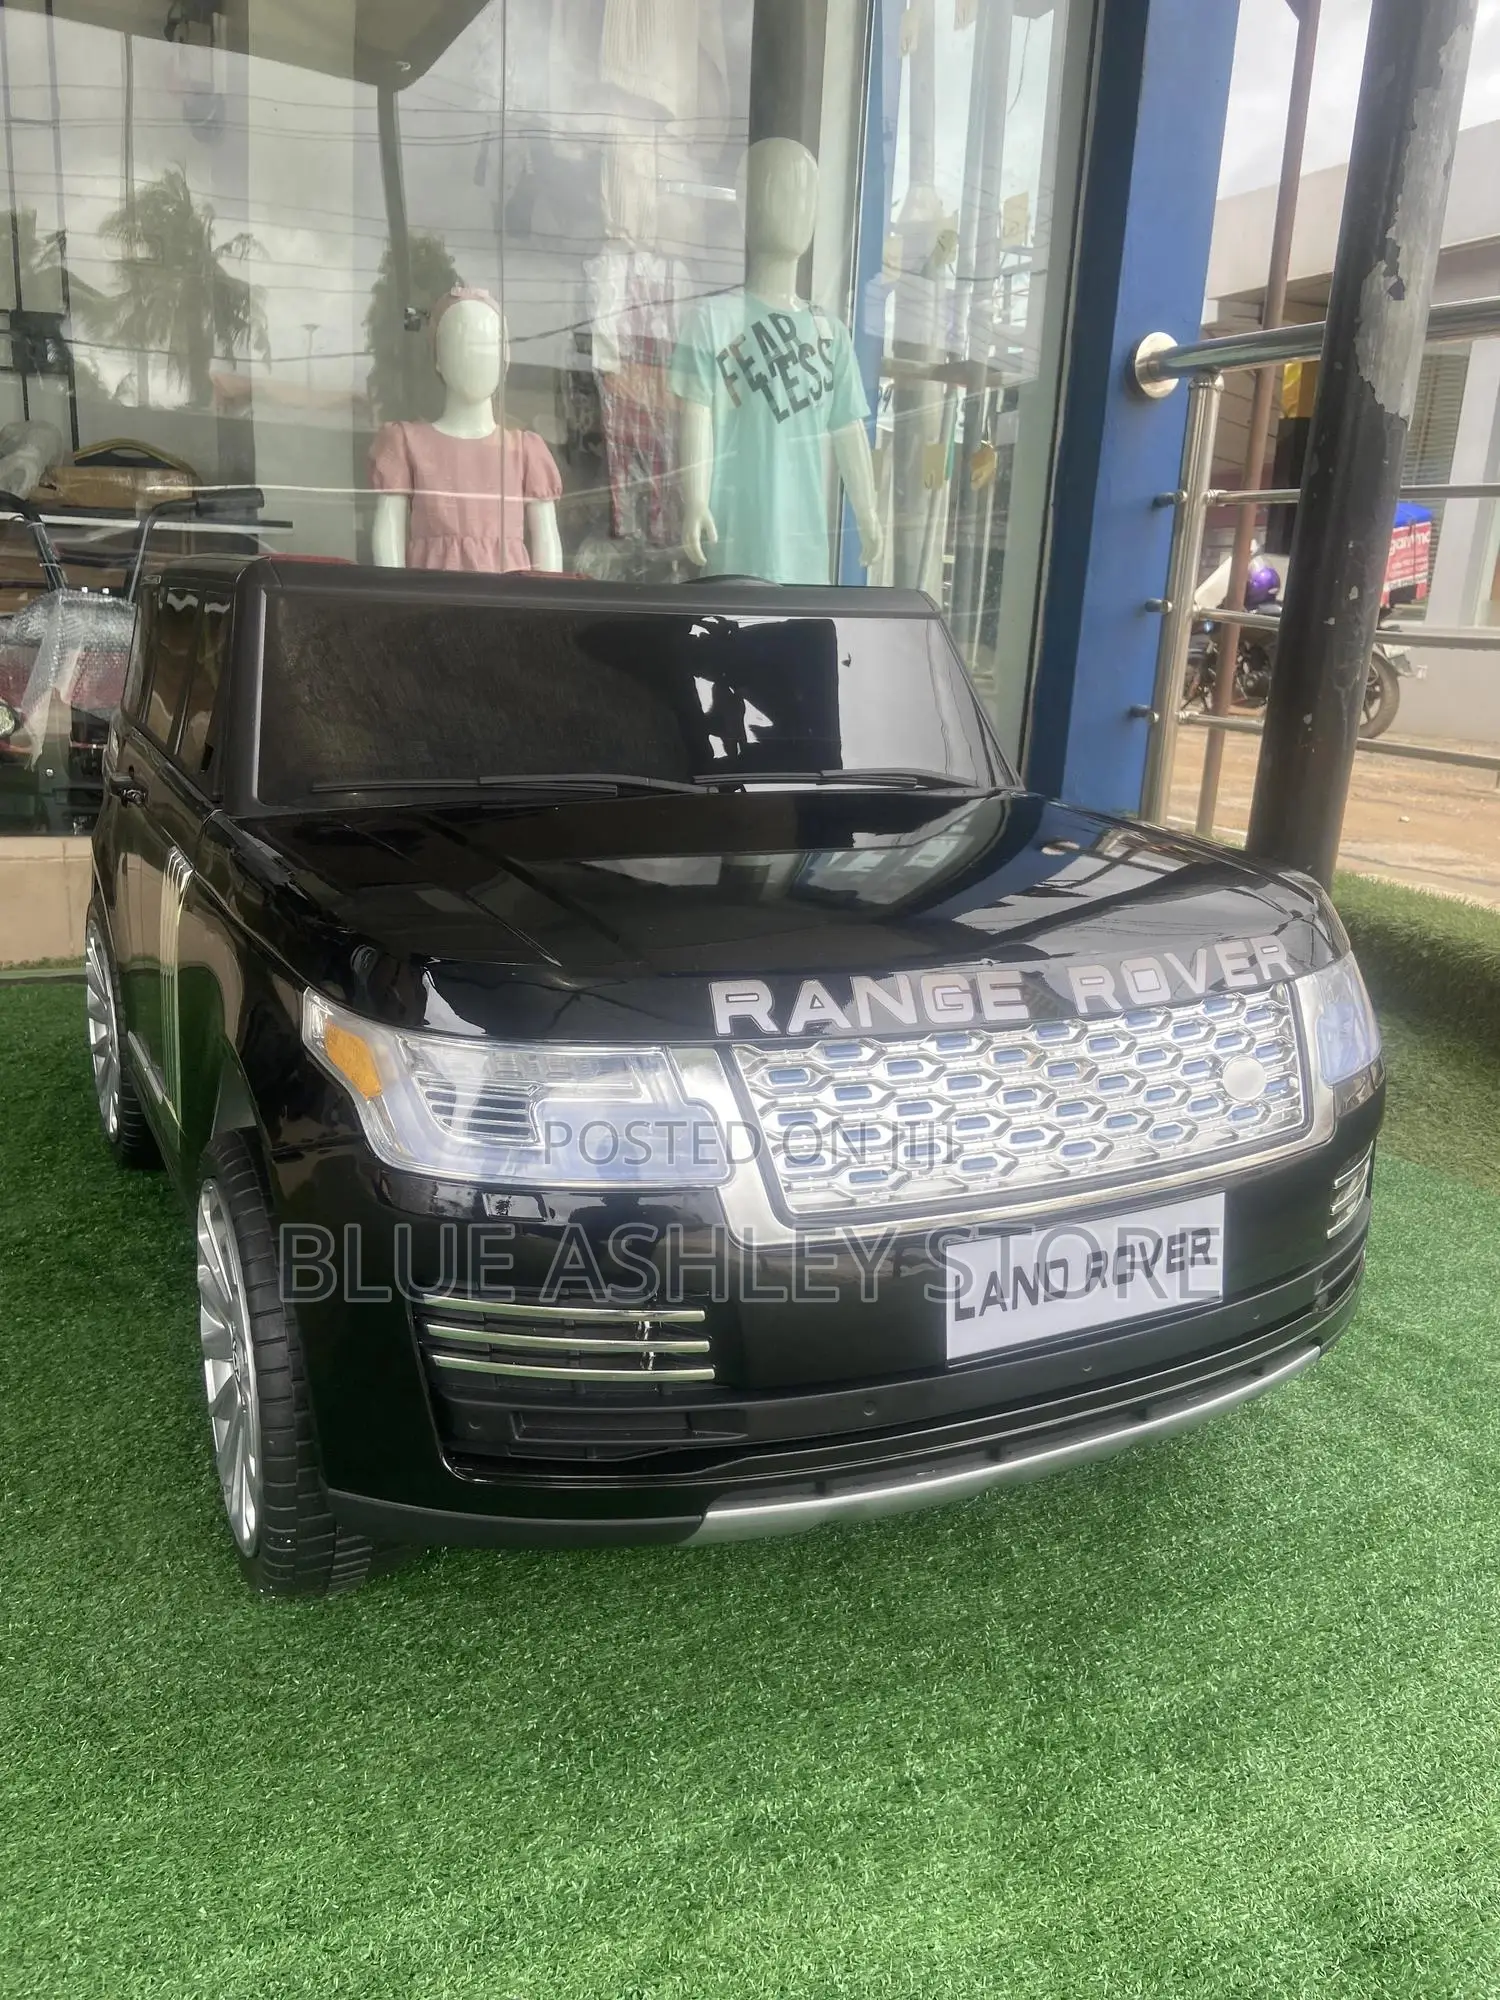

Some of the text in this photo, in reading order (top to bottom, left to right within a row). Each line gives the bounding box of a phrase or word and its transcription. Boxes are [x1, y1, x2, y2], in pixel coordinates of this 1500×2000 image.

[716, 313, 801, 408] FEAR
[757, 338, 834, 424] LESS
[708, 936, 1296, 1036] RANGE ROVER
[954, 1226, 1212, 1322] LAND ROVER
